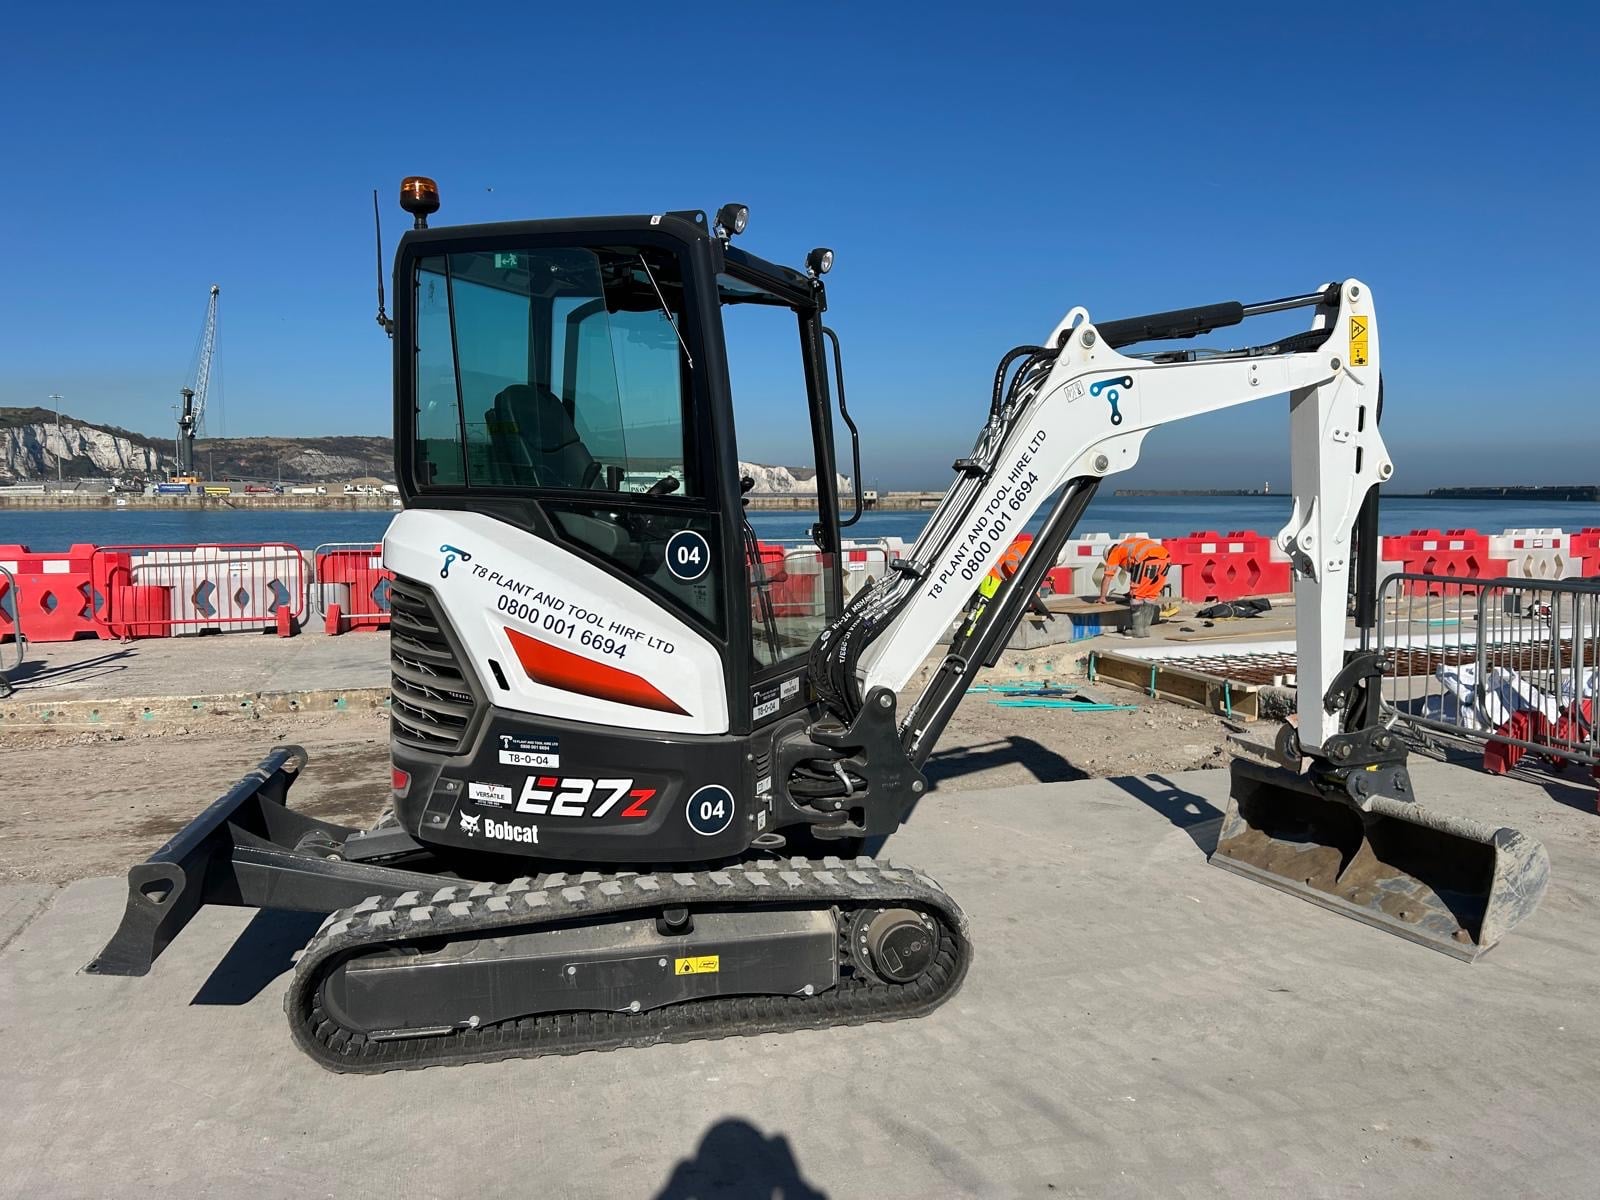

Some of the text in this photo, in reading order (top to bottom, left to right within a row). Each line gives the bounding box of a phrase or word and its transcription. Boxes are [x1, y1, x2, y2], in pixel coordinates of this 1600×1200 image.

[927, 429, 1047, 600] T8 PLANT AND TOOL HIRE LTD
[961, 471, 1040, 582] 0800 001 6694
[678, 546, 700, 564] 04
[472, 564, 488, 578] T8
[488, 571, 534, 597] PLANT
[533, 592, 565, 610] AND
[568, 604, 605, 628] TOOL
[648, 636, 675, 654] LTD
[497, 594, 628, 660] 0800 001 6694
[508, 754, 548, 764] T8-0-04
[476, 791, 504, 800] VERSATILE
[700, 800, 725, 820] 04
[484, 818, 538, 844] Bobcat
